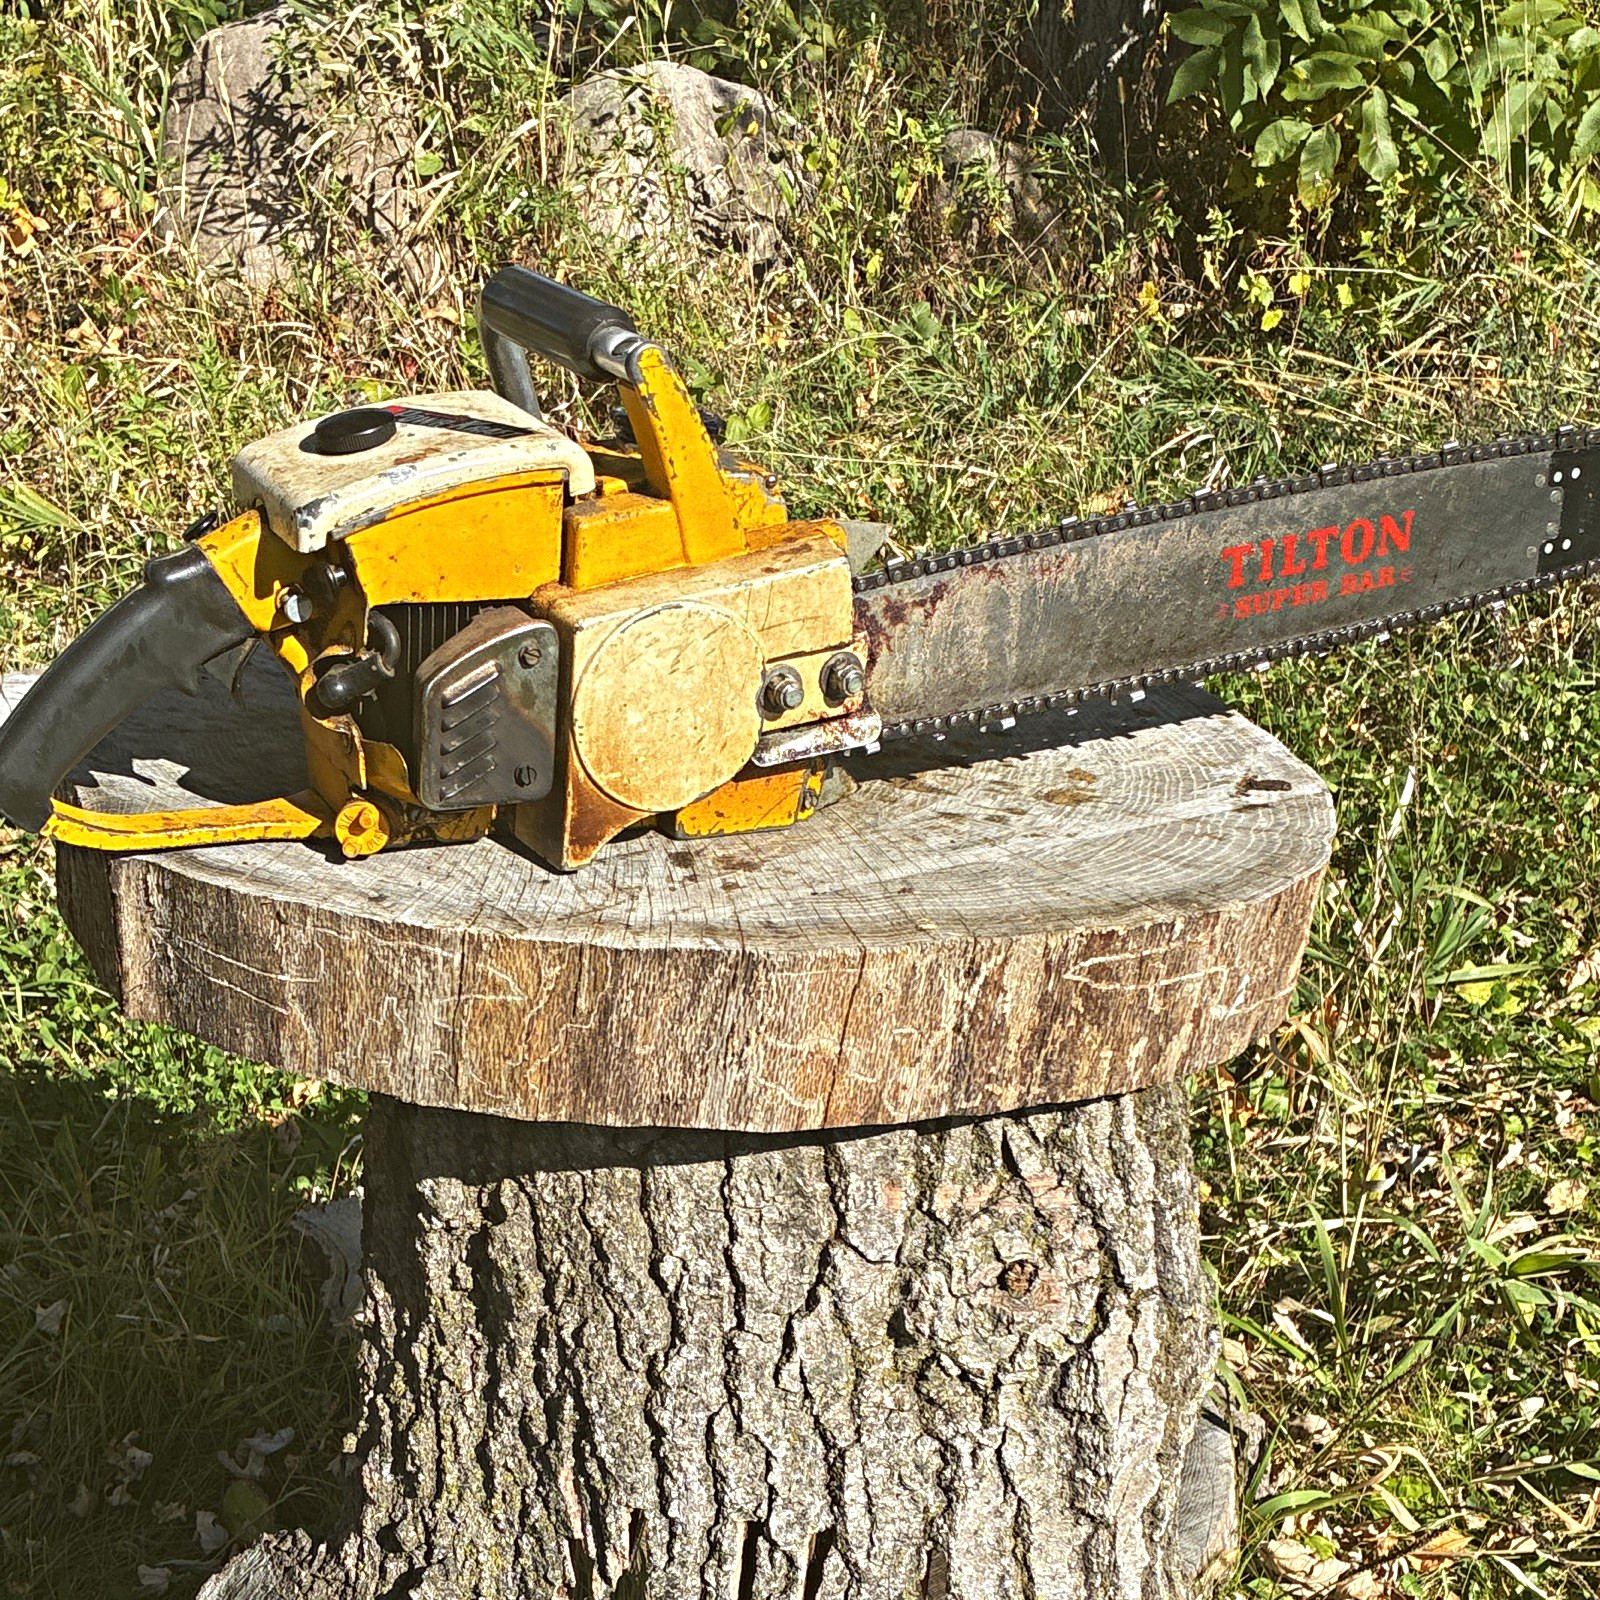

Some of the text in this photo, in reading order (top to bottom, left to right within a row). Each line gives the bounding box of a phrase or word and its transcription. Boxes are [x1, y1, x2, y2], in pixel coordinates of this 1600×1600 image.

[1221, 510, 1416, 589] TILTON
[1233, 565, 1396, 620] SUPER BAR
